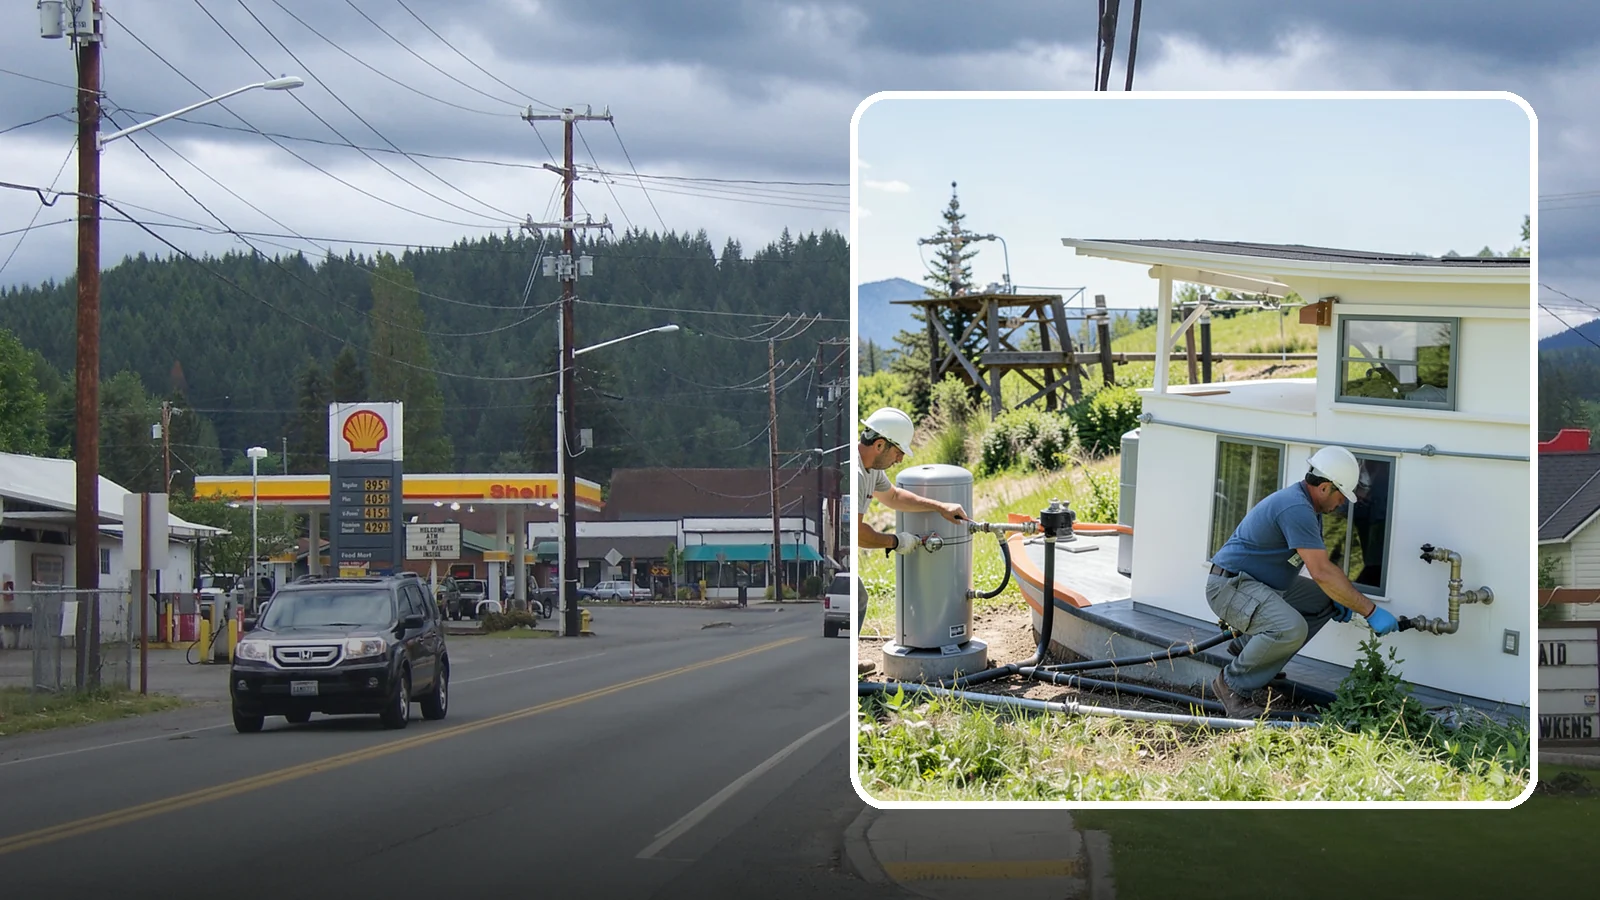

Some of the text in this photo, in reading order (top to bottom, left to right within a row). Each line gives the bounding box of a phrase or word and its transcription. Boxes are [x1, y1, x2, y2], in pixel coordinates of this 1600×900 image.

[366, 480, 383, 490] 395
[490, 484, 547, 499] Shell
[366, 494, 383, 504] 405
[366, 508, 383, 518] 415
[366, 522, 383, 532] 429
[1539, 643, 1567, 666] AID
